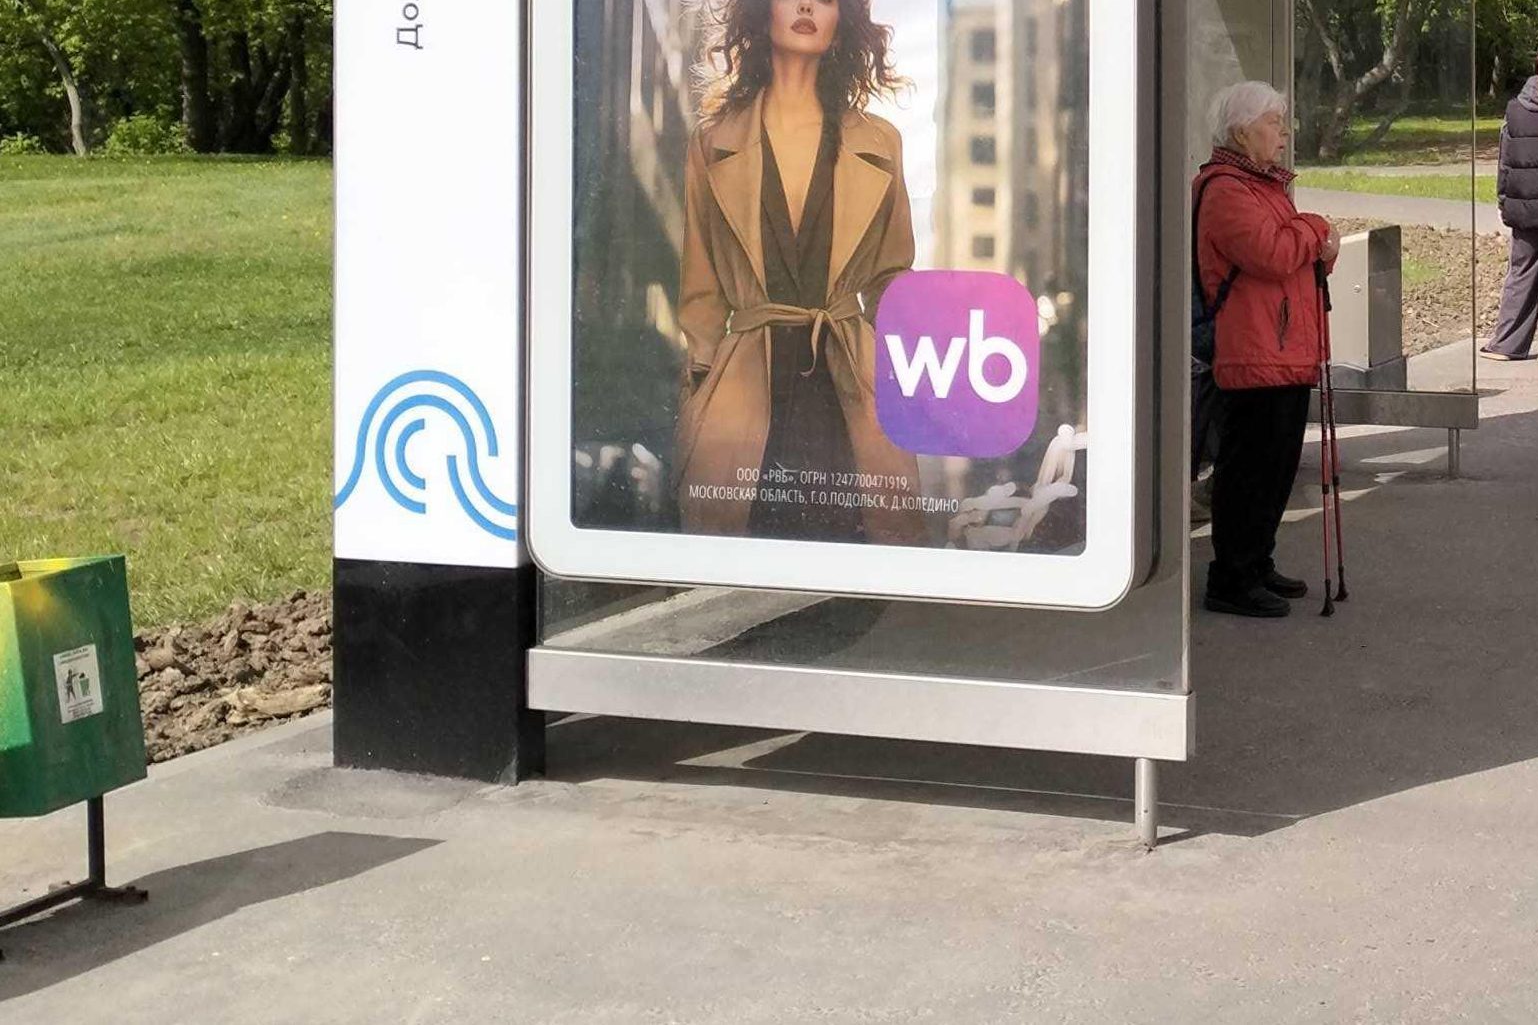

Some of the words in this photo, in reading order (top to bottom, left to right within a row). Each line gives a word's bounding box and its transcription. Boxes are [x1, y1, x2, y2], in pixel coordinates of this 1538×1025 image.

[884, 309, 1027, 403] wb
[736, 467, 760, 482] ООО
[800, 470, 827, 485] ОГРН
[689, 484, 757, 501] МОСКОВСКАЯ
[760, 488, 808, 505] ОБЛАСТЬ,
